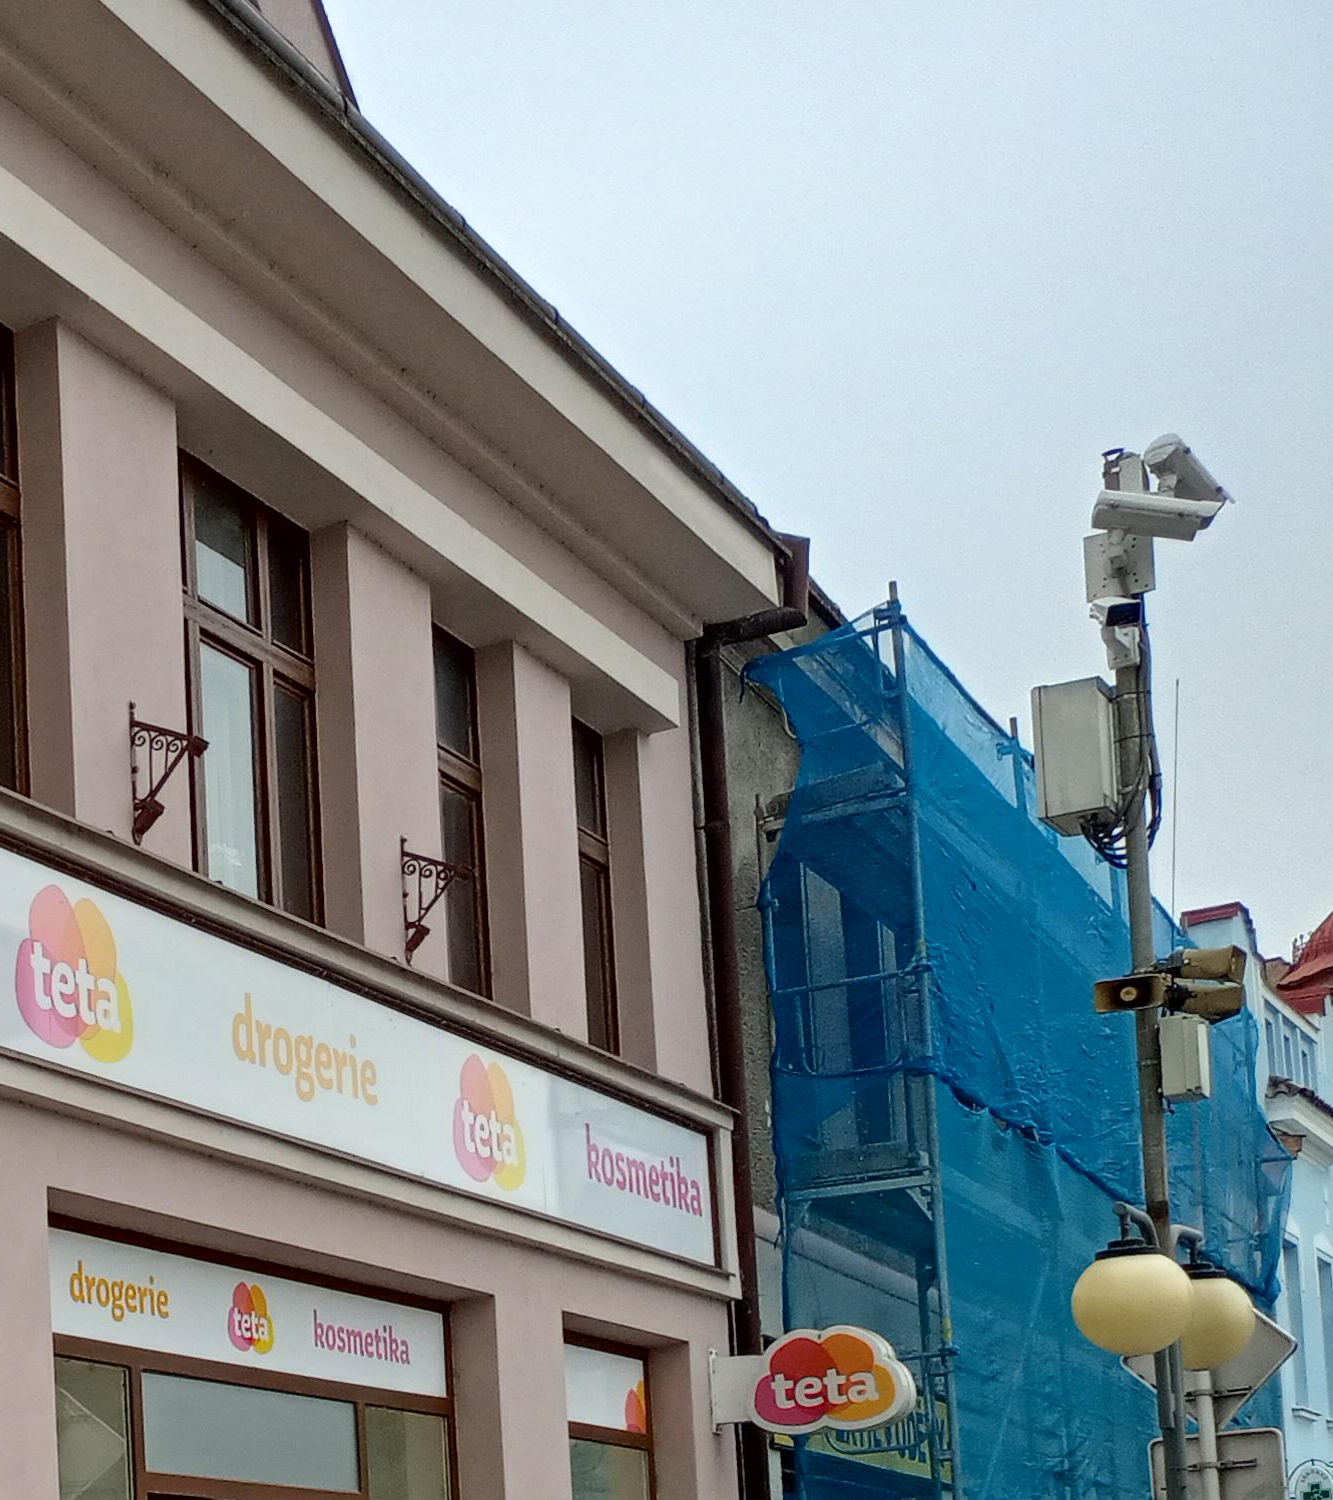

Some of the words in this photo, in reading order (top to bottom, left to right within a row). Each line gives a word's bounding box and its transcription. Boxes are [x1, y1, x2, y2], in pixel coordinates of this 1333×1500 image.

[30, 941, 123, 1034] teta
[232, 992, 379, 1106] drogerie
[460, 1099, 518, 1167] teta
[585, 1122, 703, 1218] kosmetika
[69, 1260, 170, 1322] drogerie
[233, 1307, 269, 1340] teta
[312, 1309, 411, 1365] kosmetika
[771, 1367, 879, 1410] teta
